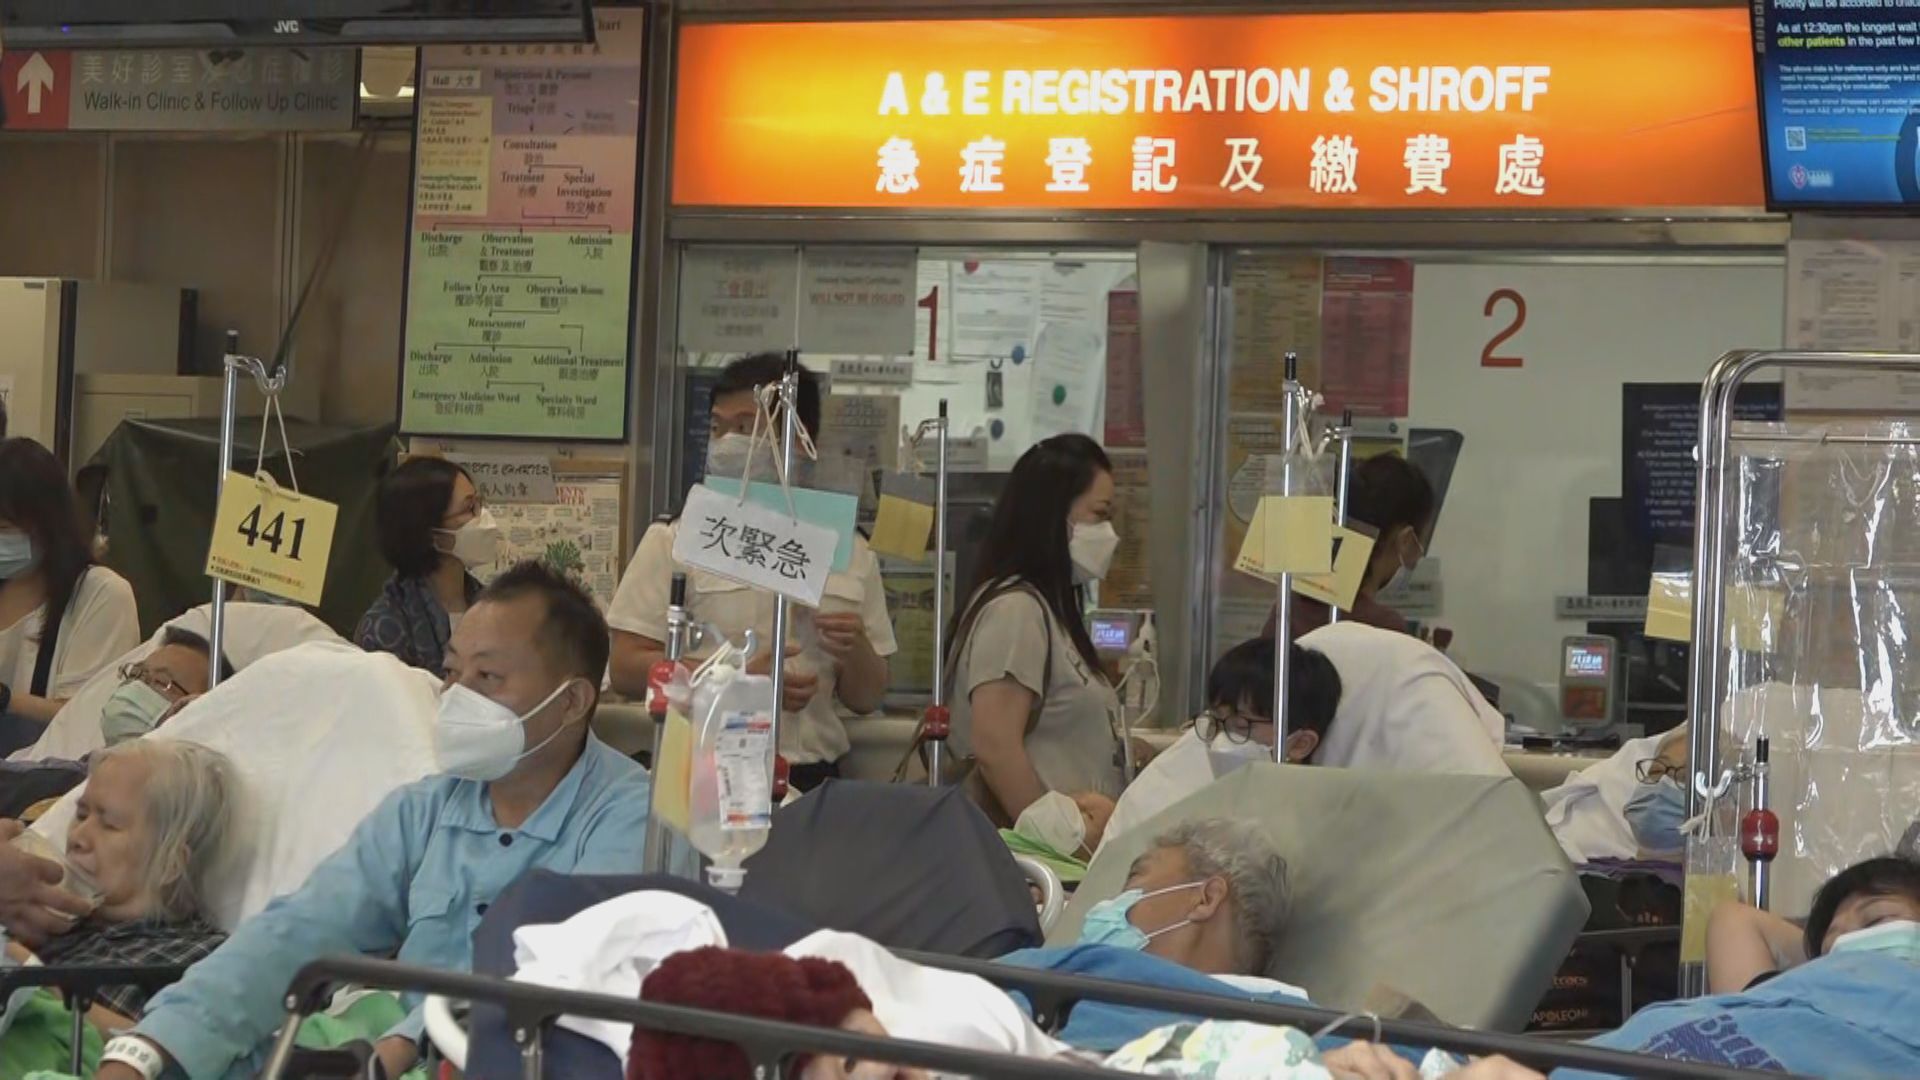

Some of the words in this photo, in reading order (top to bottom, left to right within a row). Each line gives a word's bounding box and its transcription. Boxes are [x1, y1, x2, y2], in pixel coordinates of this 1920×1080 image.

[1774, 0, 1806, 11] Priority
[1808, 0, 1824, 8] will
[1825, 0, 1838, 8] be
[1840, 0, 1882, 8] accorded
[1884, 0, 1894, 8] to
[274, 20, 298, 33] JVC
[1776, 22, 1789, 33] As
[1791, 23, 1801, 33] at
[1803, 22, 1843, 35] 12:30pm
[1844, 22, 1860, 33] the
[1861, 22, 1895, 35] longest
[1897, 22, 1917, 32] wait
[1778, 36, 1804, 47] other
[1806, 36, 1845, 49] patients
[1848, 35, 1857, 46] in
[1858, 36, 1874, 46] the
[1875, 36, 1896, 48] past
[1897, 35, 1915, 46] few
[880, 71, 909, 116] A
[921, 71, 950, 116] &
[963, 70, 990, 116] E
[1003, 67, 1310, 116] REGISTRATION
[1324, 66, 1354, 113] &
[1369, 64, 1550, 114] SHROFF
[84, 91, 141, 111] Walk-in
[147, 91, 189, 111] Clinic
[195, 92, 205, 111] &
[212, 91, 261, 111] Follow
[268, 91, 289, 114] Up
[295, 91, 339, 111] Clinic
[503, 140, 557, 150] Consultation
[876, 134, 1546, 197] 急症登記及繳費處
[502, 172, 544, 183] Treatment
[564, 173, 595, 186] Special
[557, 187, 612, 199] Investigation
[421, 233, 463, 245] Discharge
[482, 233, 533, 244] Observation
[568, 235, 613, 246] Admission
[491, 247, 534, 257] Treatment
[443, 282, 471, 293] Follow
[475, 283, 486, 296] Up
[491, 284, 510, 294] Area
[526, 285, 578, 295] Observation
[468, 318, 526, 328] Reassessment
[917, 284, 939, 363] 1
[1480, 287, 1527, 370] 2
[410, 351, 453, 363] Discharge
[469, 353, 512, 364] Admission
[533, 355, 577, 366] Additional
[579, 357, 624, 367] Treatment
[412, 390, 456, 402] Emergency
[459, 391, 496, 402] Medicine
[498, 393, 520, 403] Ward
[536, 395, 572, 406] Specialty
[575, 396, 597, 405] Ward
[237, 503, 305, 561] 441
[699, 516, 812, 581] 次緊急
